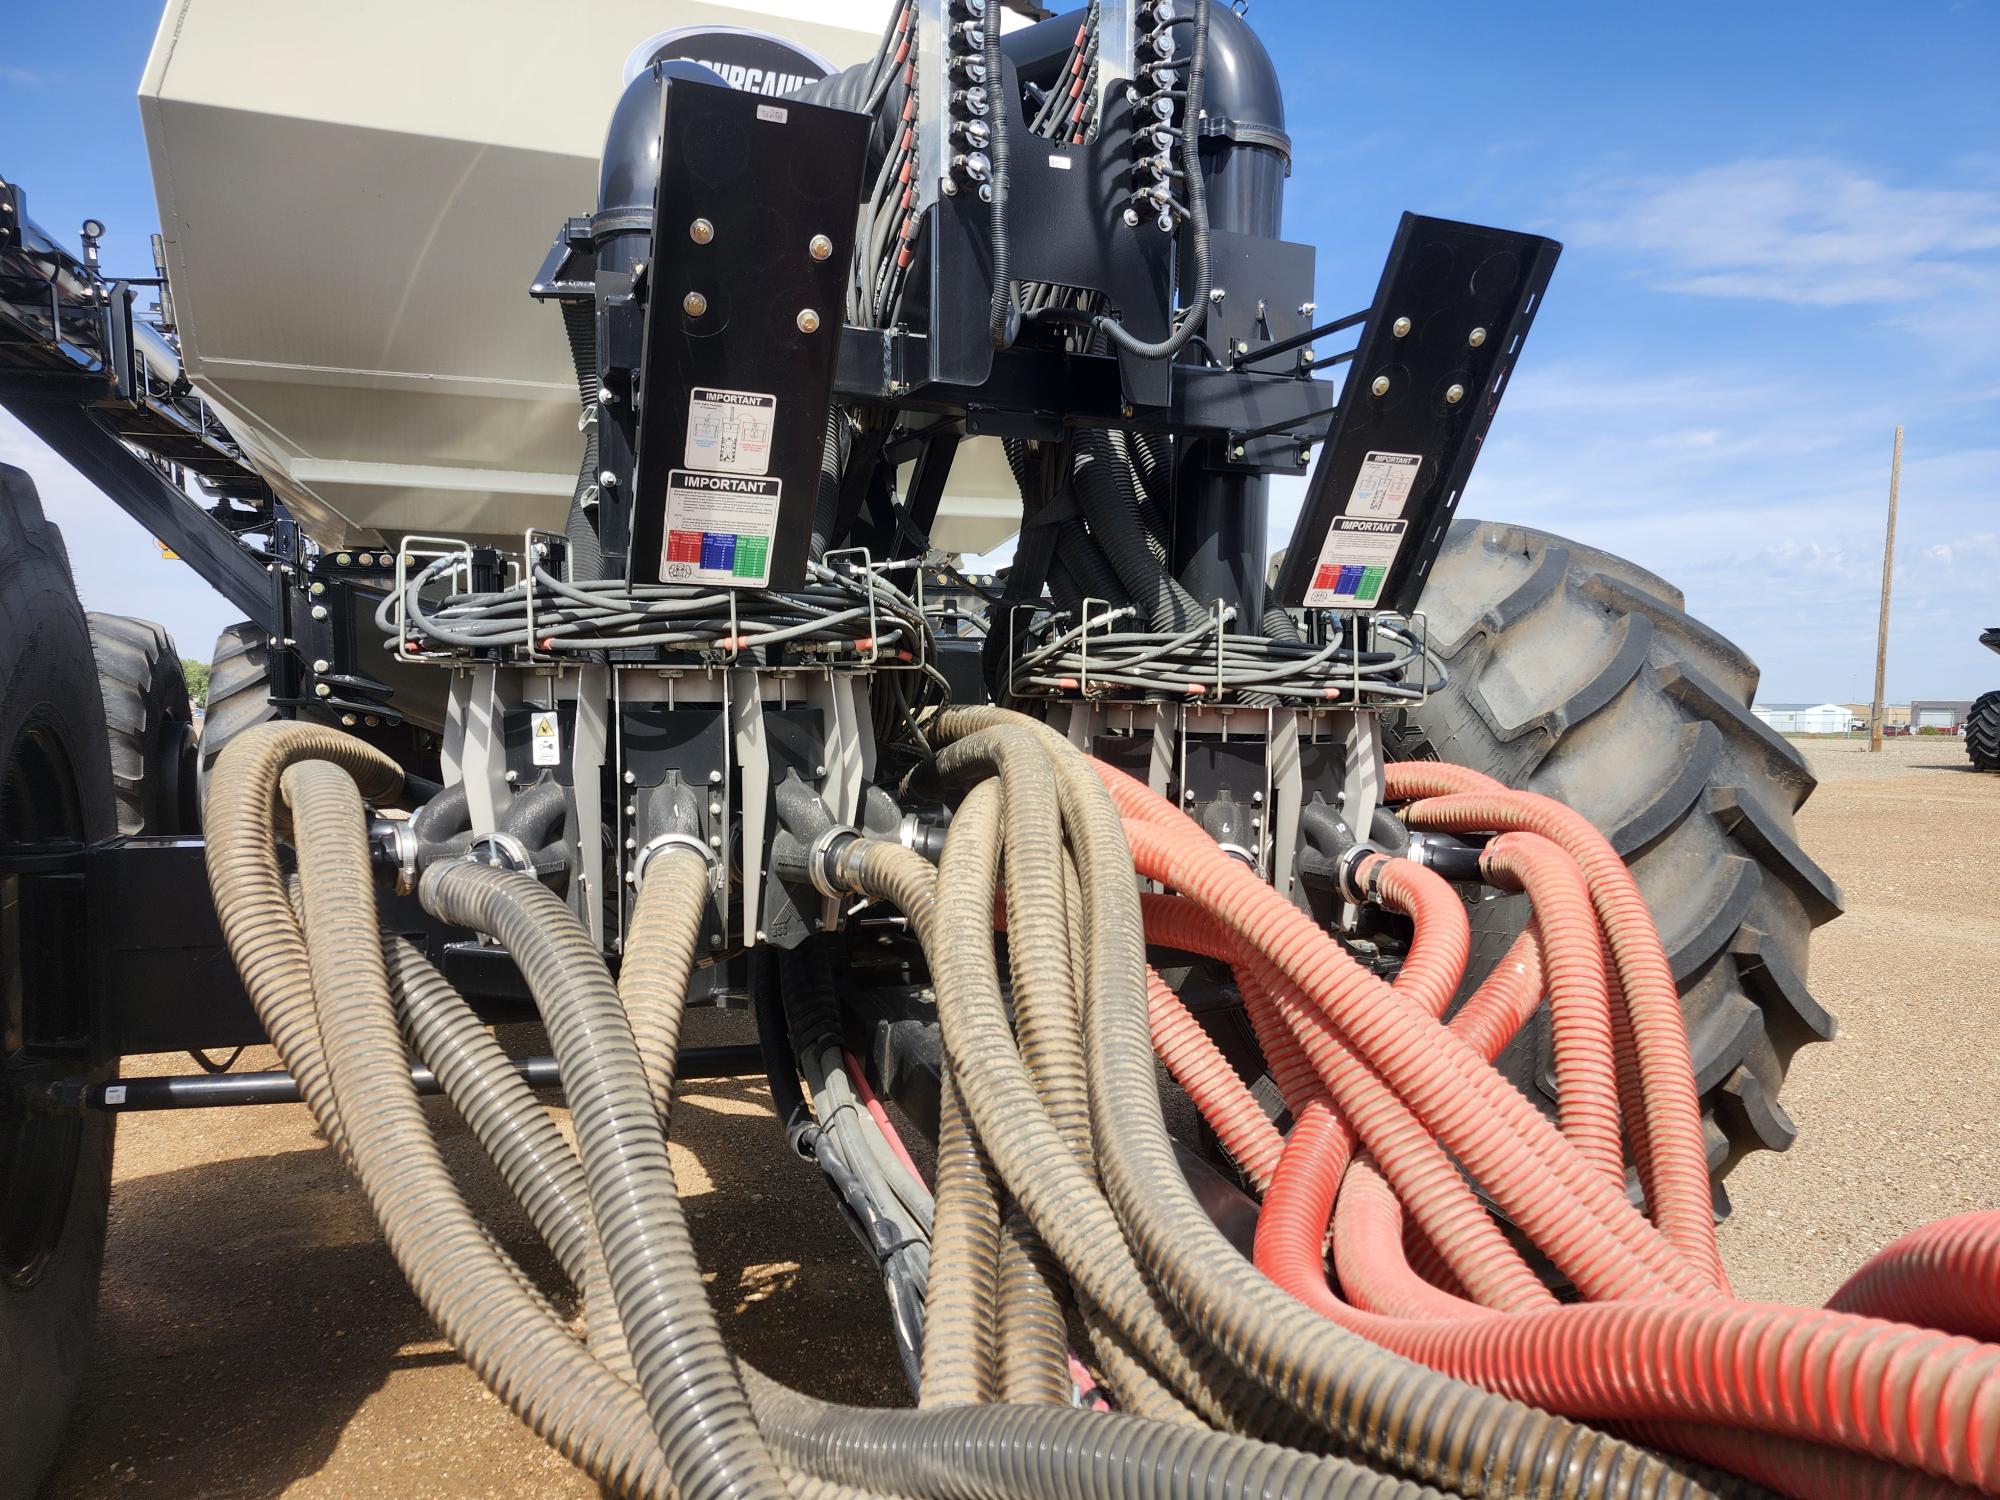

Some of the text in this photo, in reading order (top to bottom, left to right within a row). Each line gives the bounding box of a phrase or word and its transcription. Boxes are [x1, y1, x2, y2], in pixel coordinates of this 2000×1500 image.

[706, 392, 762, 406] IMPORTANT
[1374, 455, 1413, 464] IMPORTANT
[684, 475, 767, 493] IMPORTANT
[1340, 520, 1398, 532] IMPORTANT
[1222, 822, 1230, 833] 6
